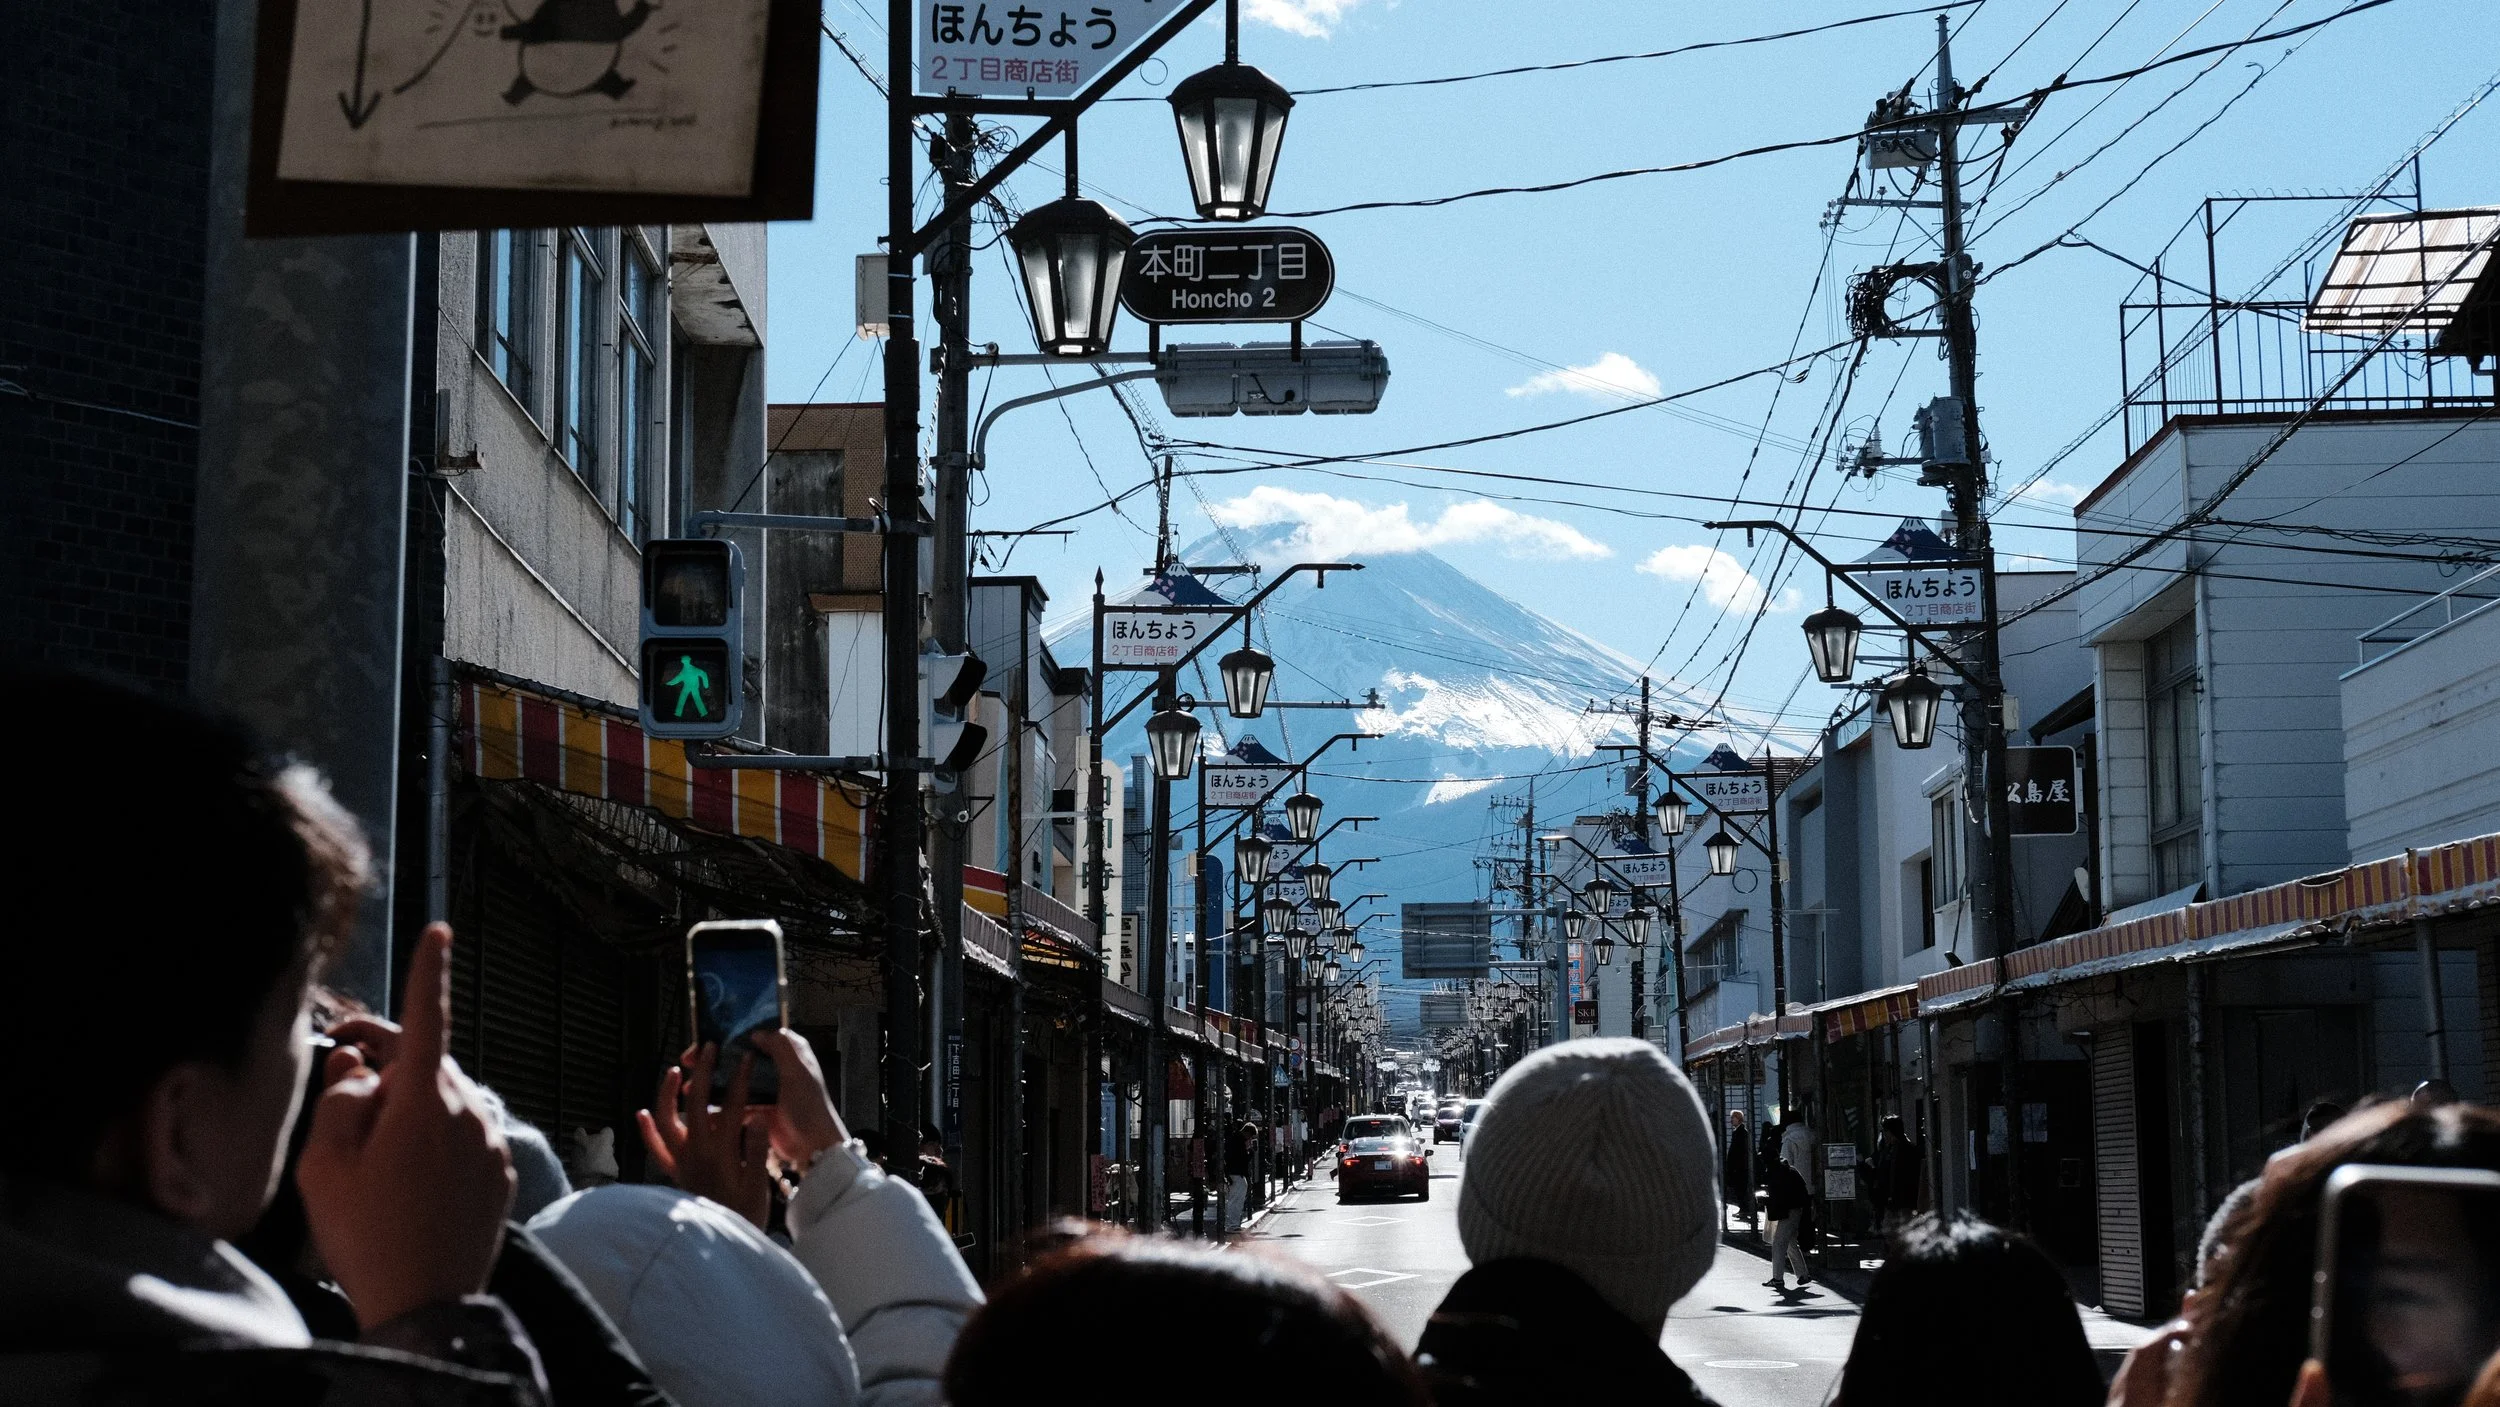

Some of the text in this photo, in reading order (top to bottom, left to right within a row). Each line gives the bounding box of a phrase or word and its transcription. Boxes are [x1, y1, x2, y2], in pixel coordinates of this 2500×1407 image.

[932, 3, 1117, 50] ほんちょう
[931, 55, 1079, 85] 2丁目商店街
[1139, 243, 1307, 283] 本町二丁目
[1171, 288, 1276, 310] Honcho 2
[1885, 575, 1977, 600] ほんちょう
[1112, 619, 1197, 640] ほんちょう
[1210, 774, 1270, 789] ほんちょう
[1705, 780, 1763, 796] ほんちょう
[1623, 861, 1667, 874] ほんちょう
[952, 1043, 960, 1108] 下吉田二丁目
